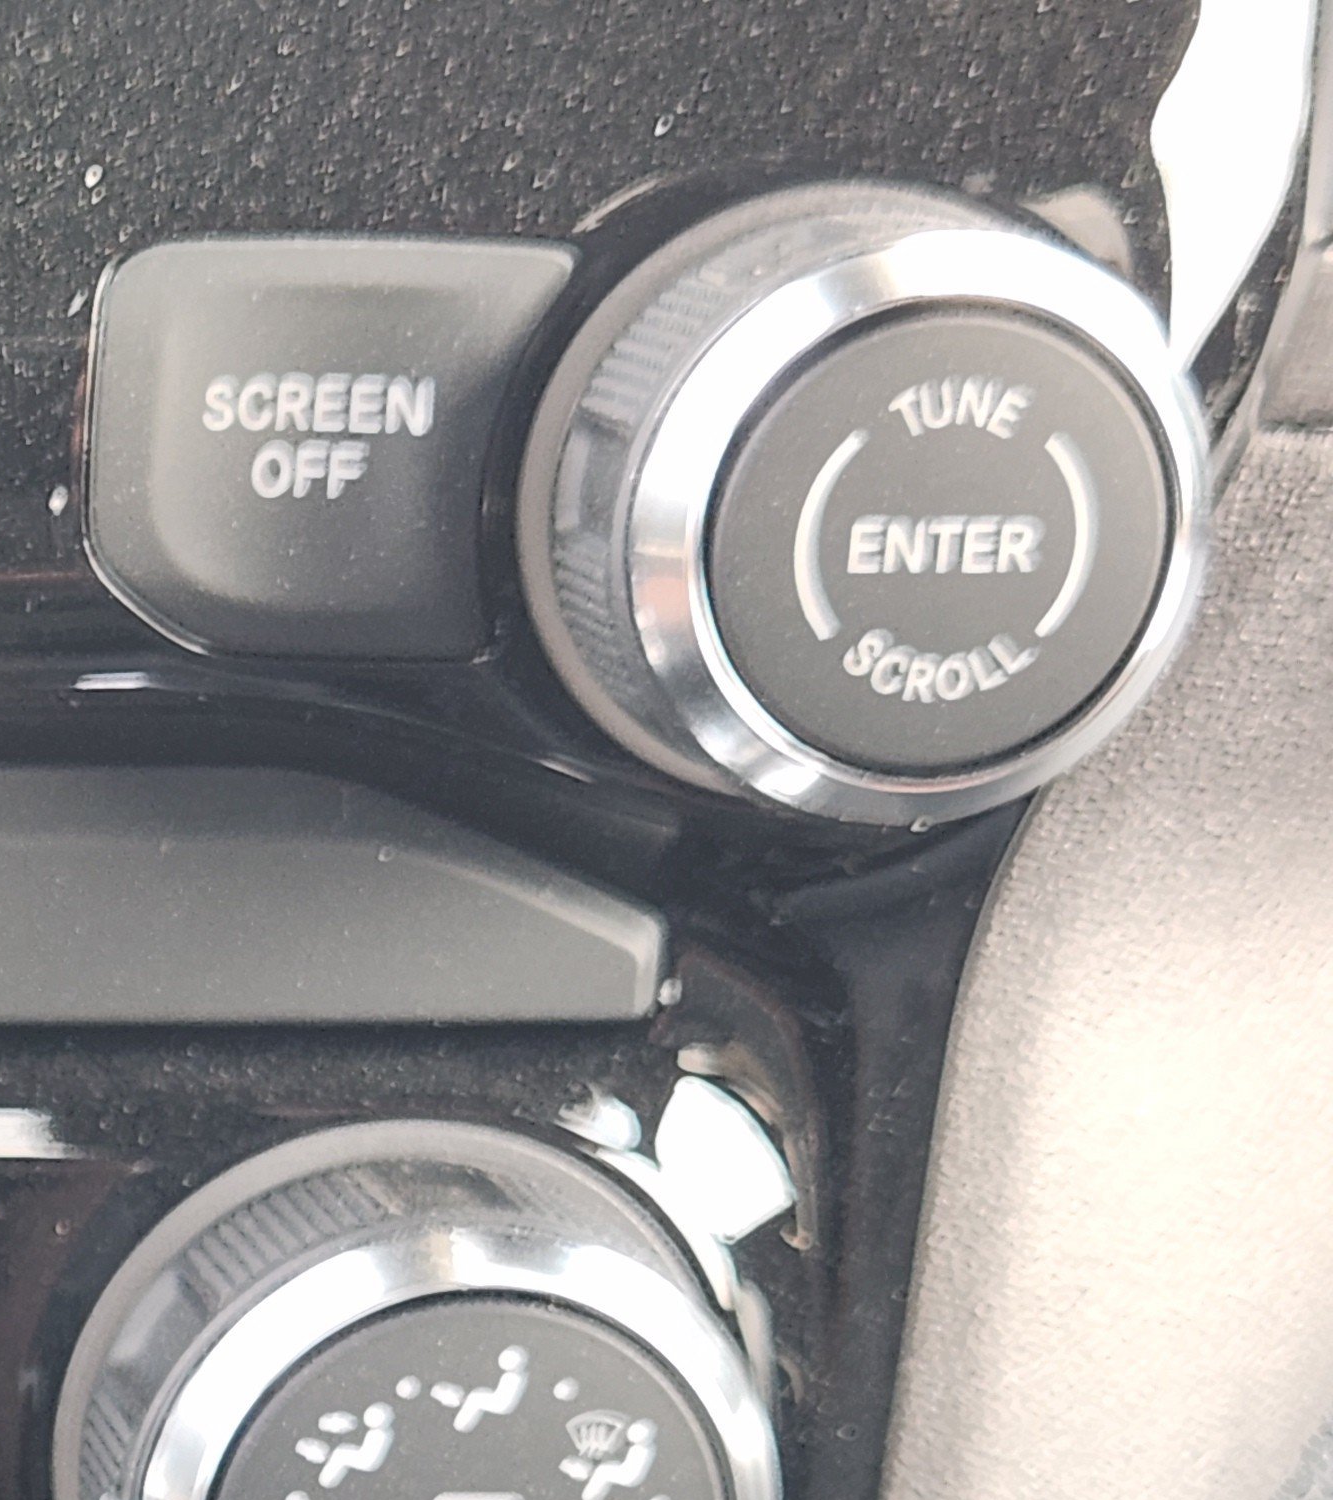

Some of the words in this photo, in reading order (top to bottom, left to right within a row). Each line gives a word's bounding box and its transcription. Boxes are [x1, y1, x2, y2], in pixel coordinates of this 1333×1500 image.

[201, 372, 435, 436] SCREEN
[888, 376, 1034, 437] TUNE
[250, 440, 369, 500] OFF
[846, 514, 1045, 575] ENTER
[841, 627, 1041, 703] SCROLL
